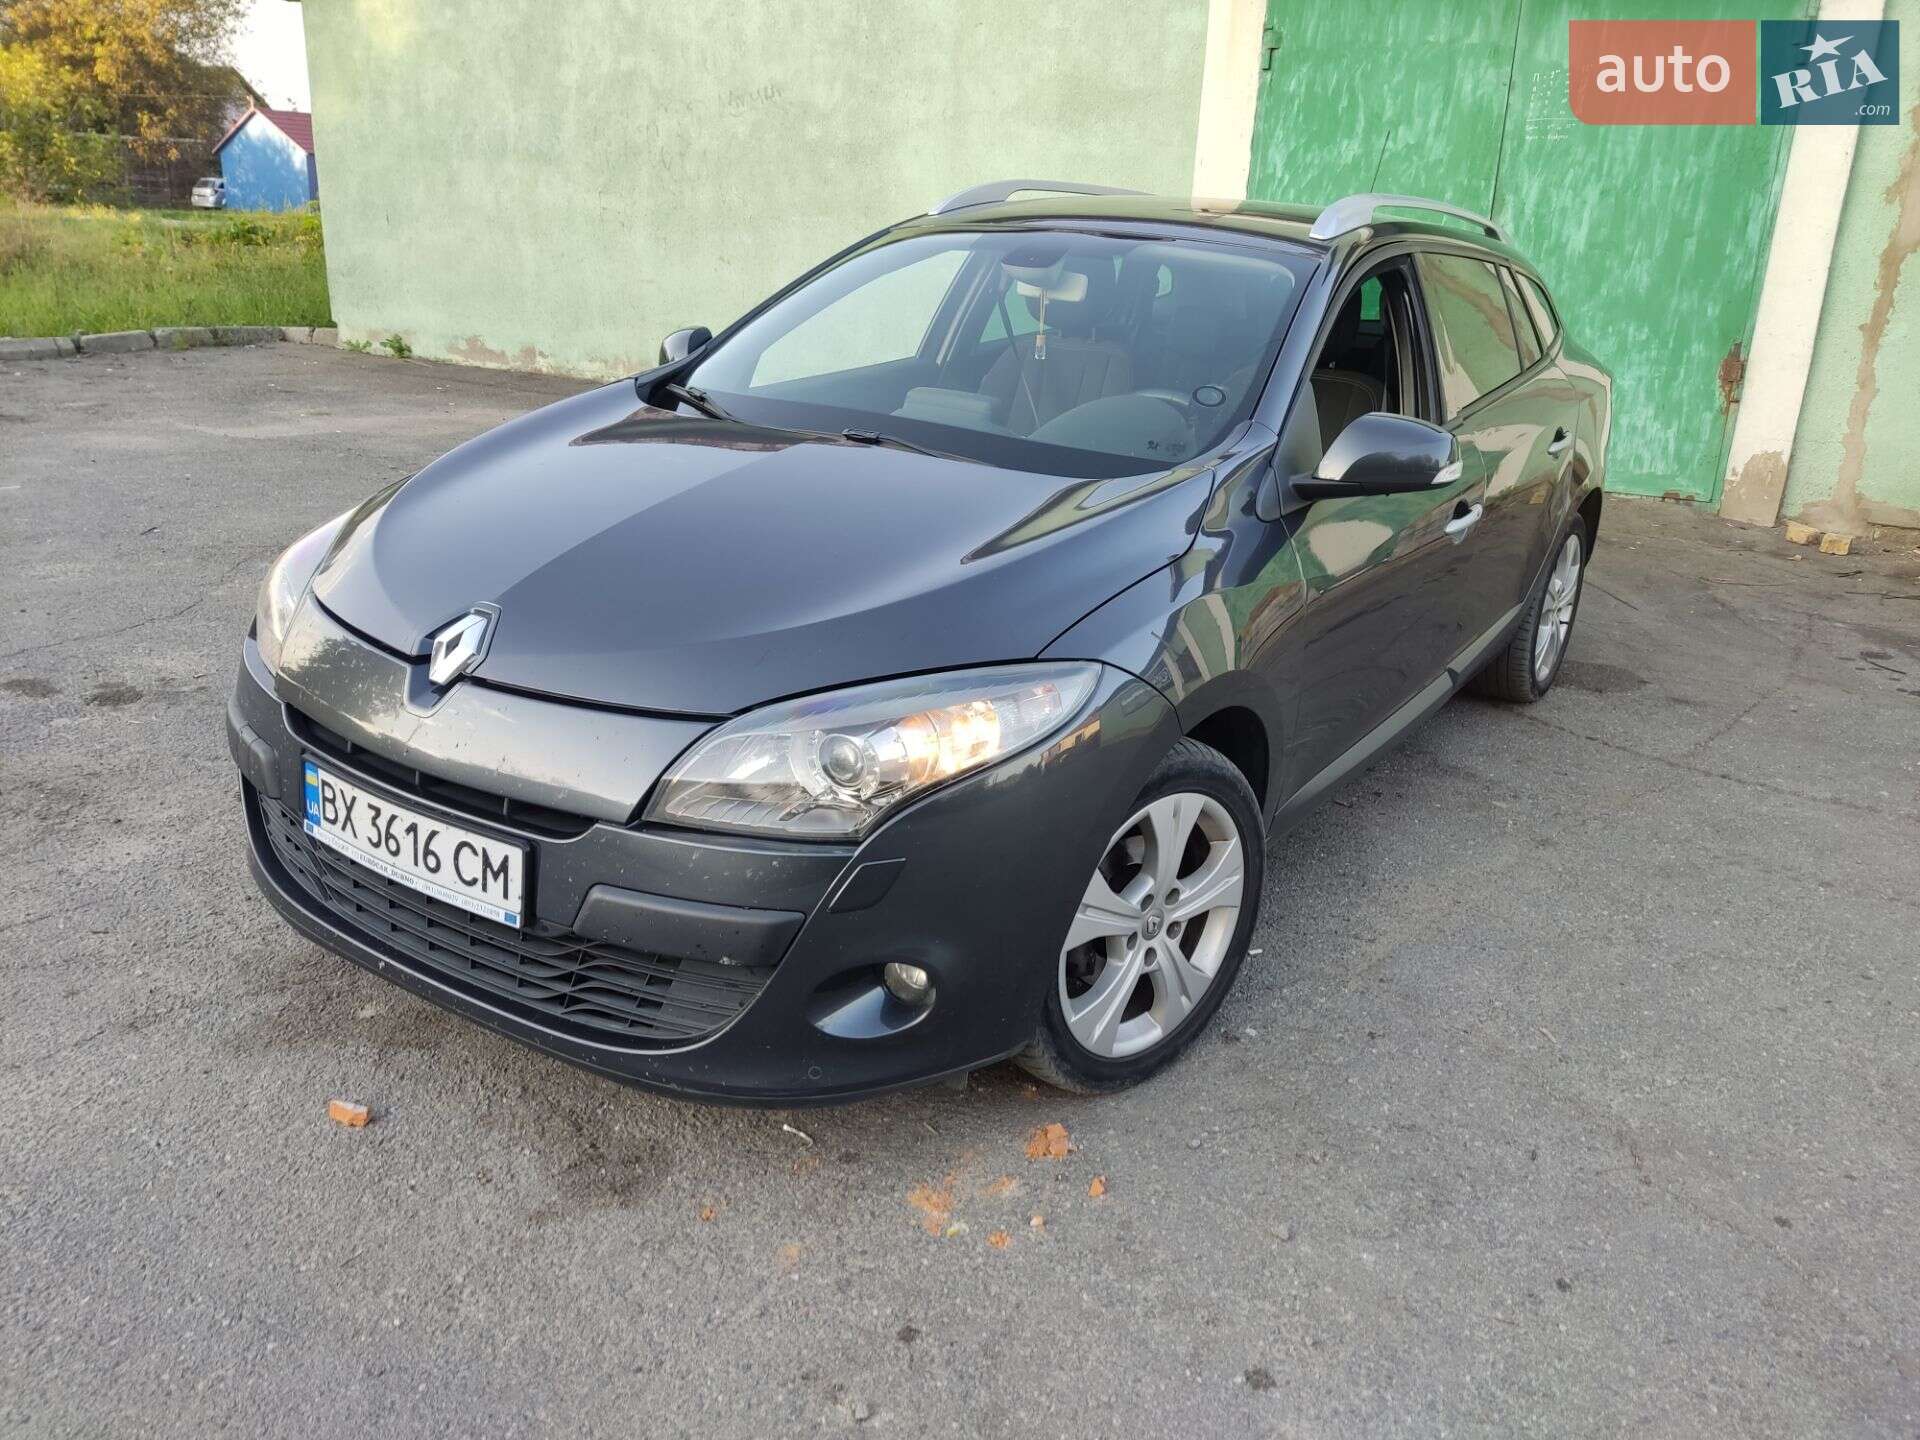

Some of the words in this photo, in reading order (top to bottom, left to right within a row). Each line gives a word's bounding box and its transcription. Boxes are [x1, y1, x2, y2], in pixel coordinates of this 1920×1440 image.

[306, 801, 320, 817] UA
[320, 778, 358, 839] BX
[366, 803, 441, 874] 3616
[453, 840, 509, 900] CM
